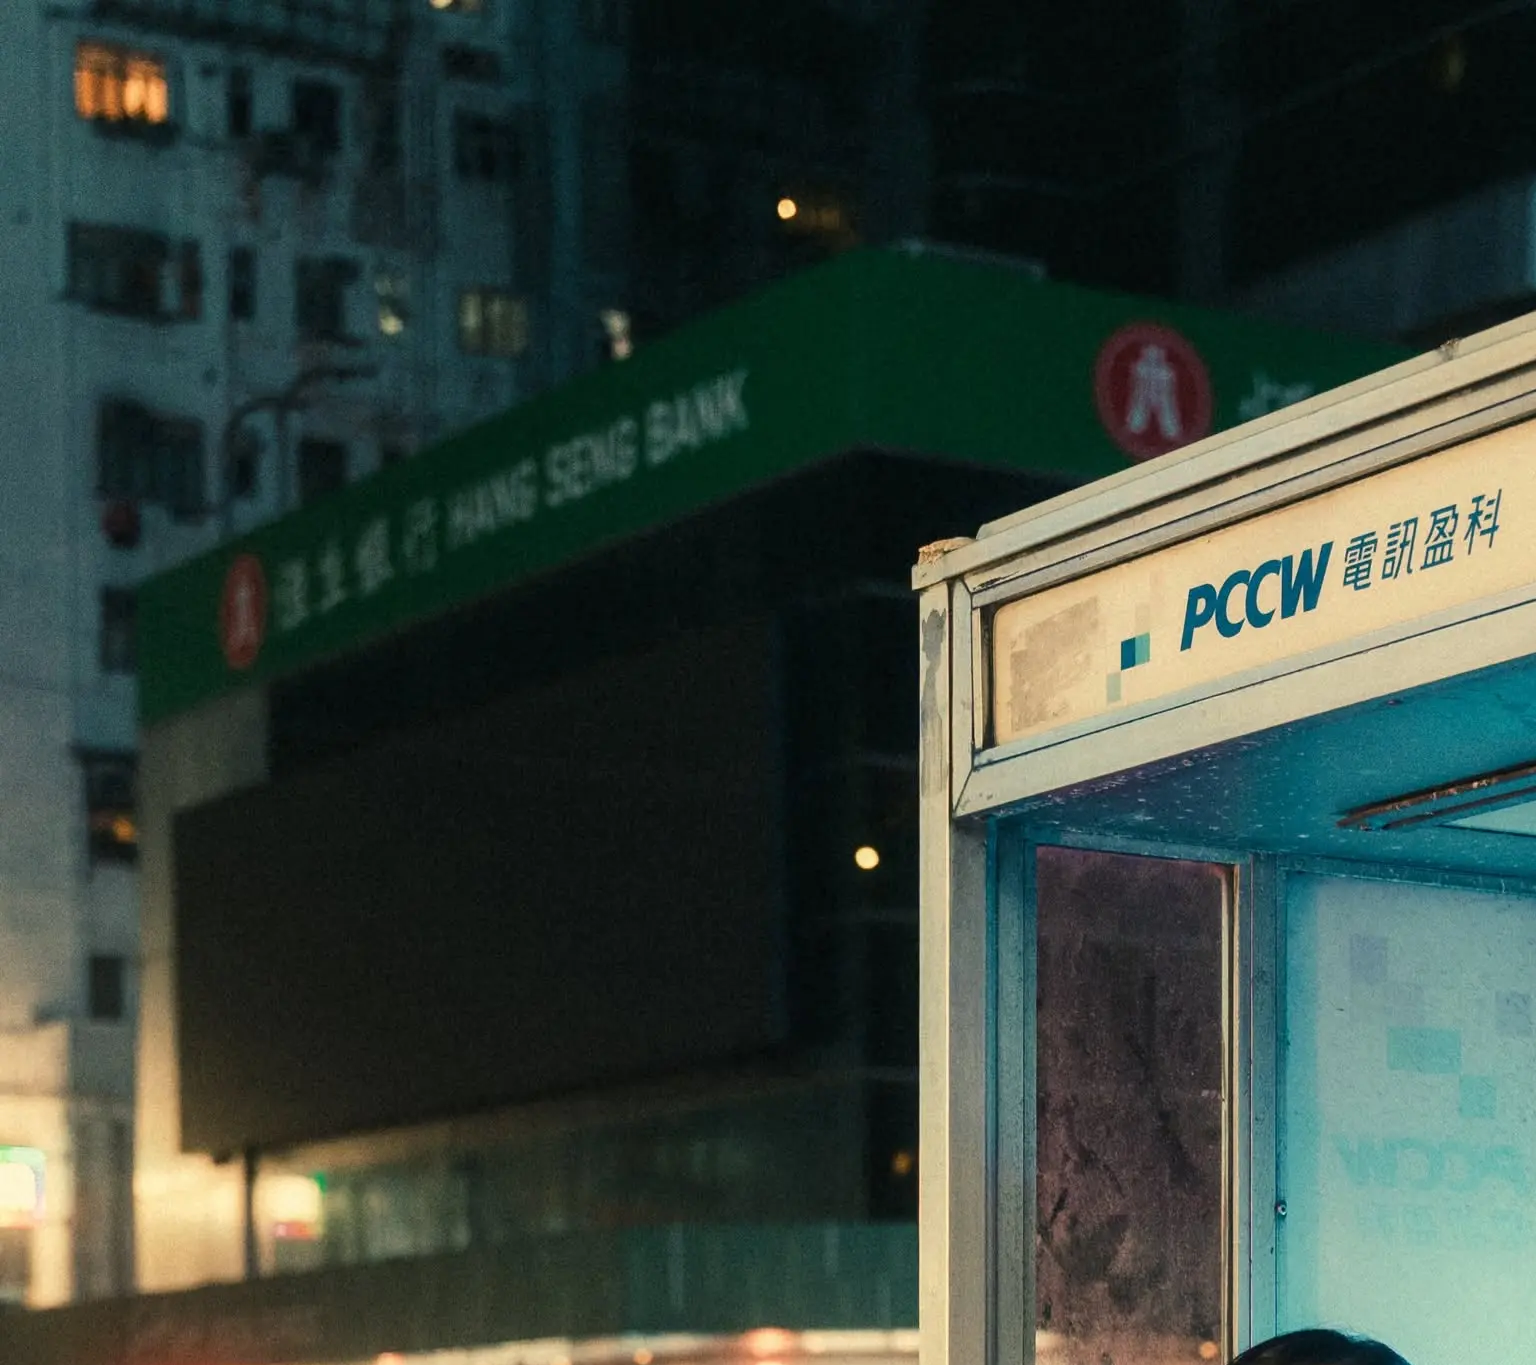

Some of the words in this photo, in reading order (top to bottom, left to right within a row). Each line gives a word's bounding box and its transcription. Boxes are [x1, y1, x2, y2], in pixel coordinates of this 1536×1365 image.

[546, 414, 638, 507] SENG
[645, 370, 748, 467] BANK
[1343, 489, 1503, 591] 電訊盈科
[1180, 541, 1334, 652] PCCW
